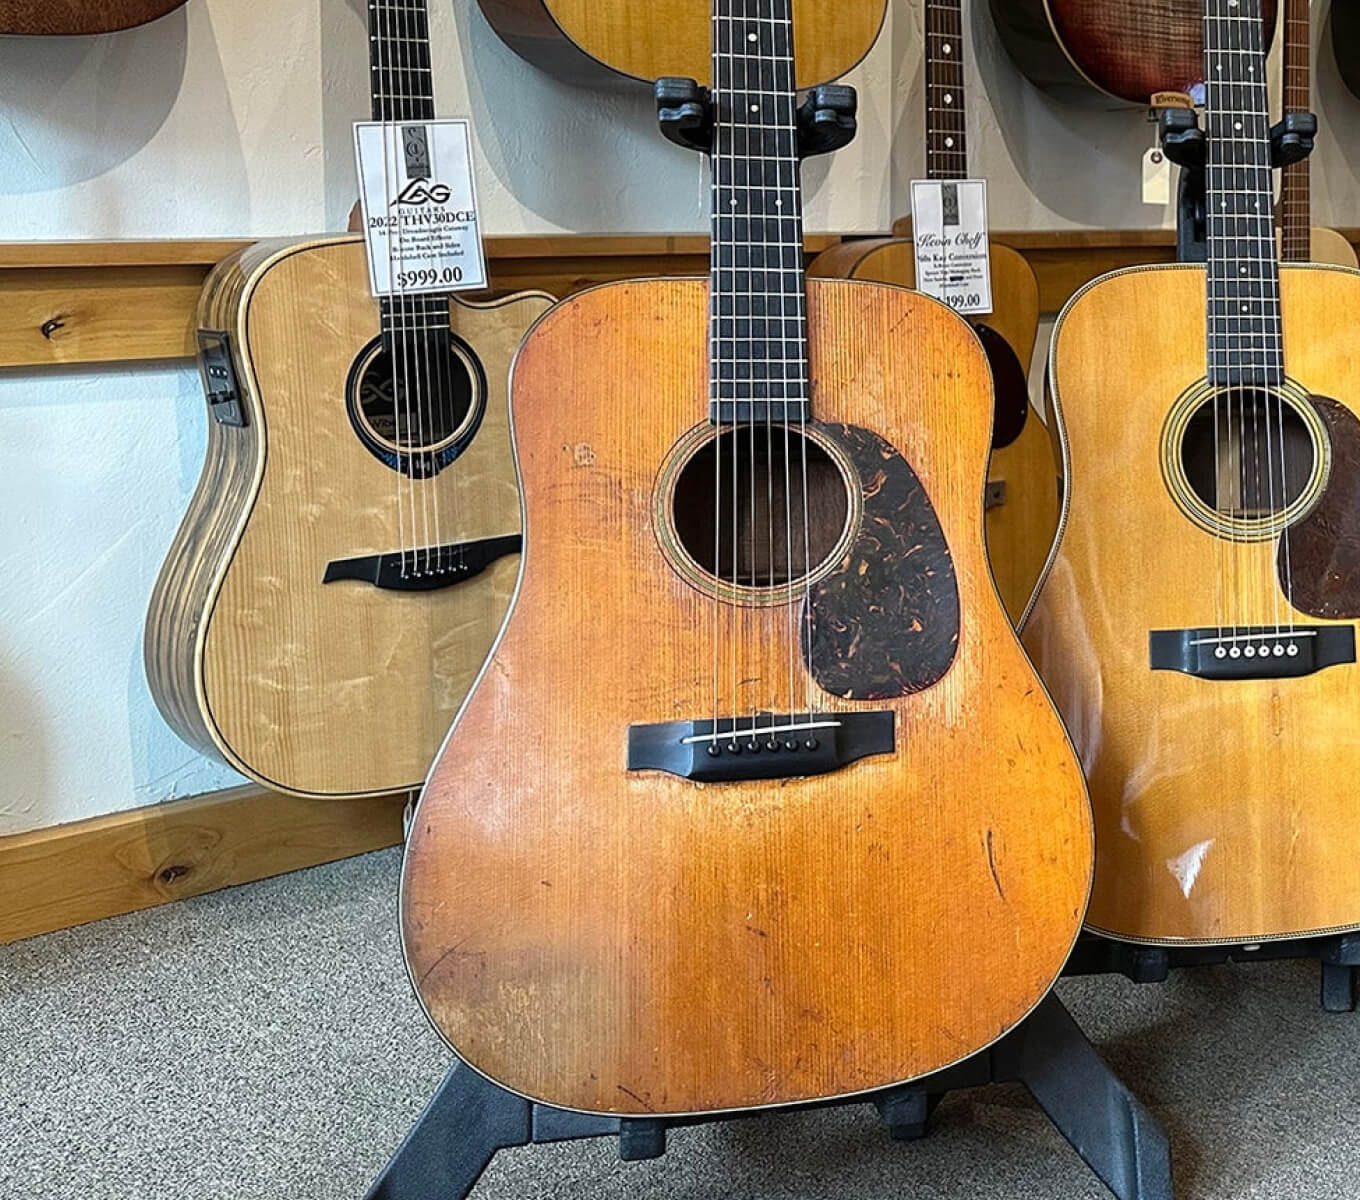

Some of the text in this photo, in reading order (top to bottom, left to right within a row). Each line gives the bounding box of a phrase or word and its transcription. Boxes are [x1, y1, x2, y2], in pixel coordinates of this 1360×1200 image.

[398, 206, 446, 215] GUITARS
[368, 211, 476, 228] 2022 THV30DCE
[916, 233, 951, 248] Kevin
[397, 266, 463, 288] $999.00
